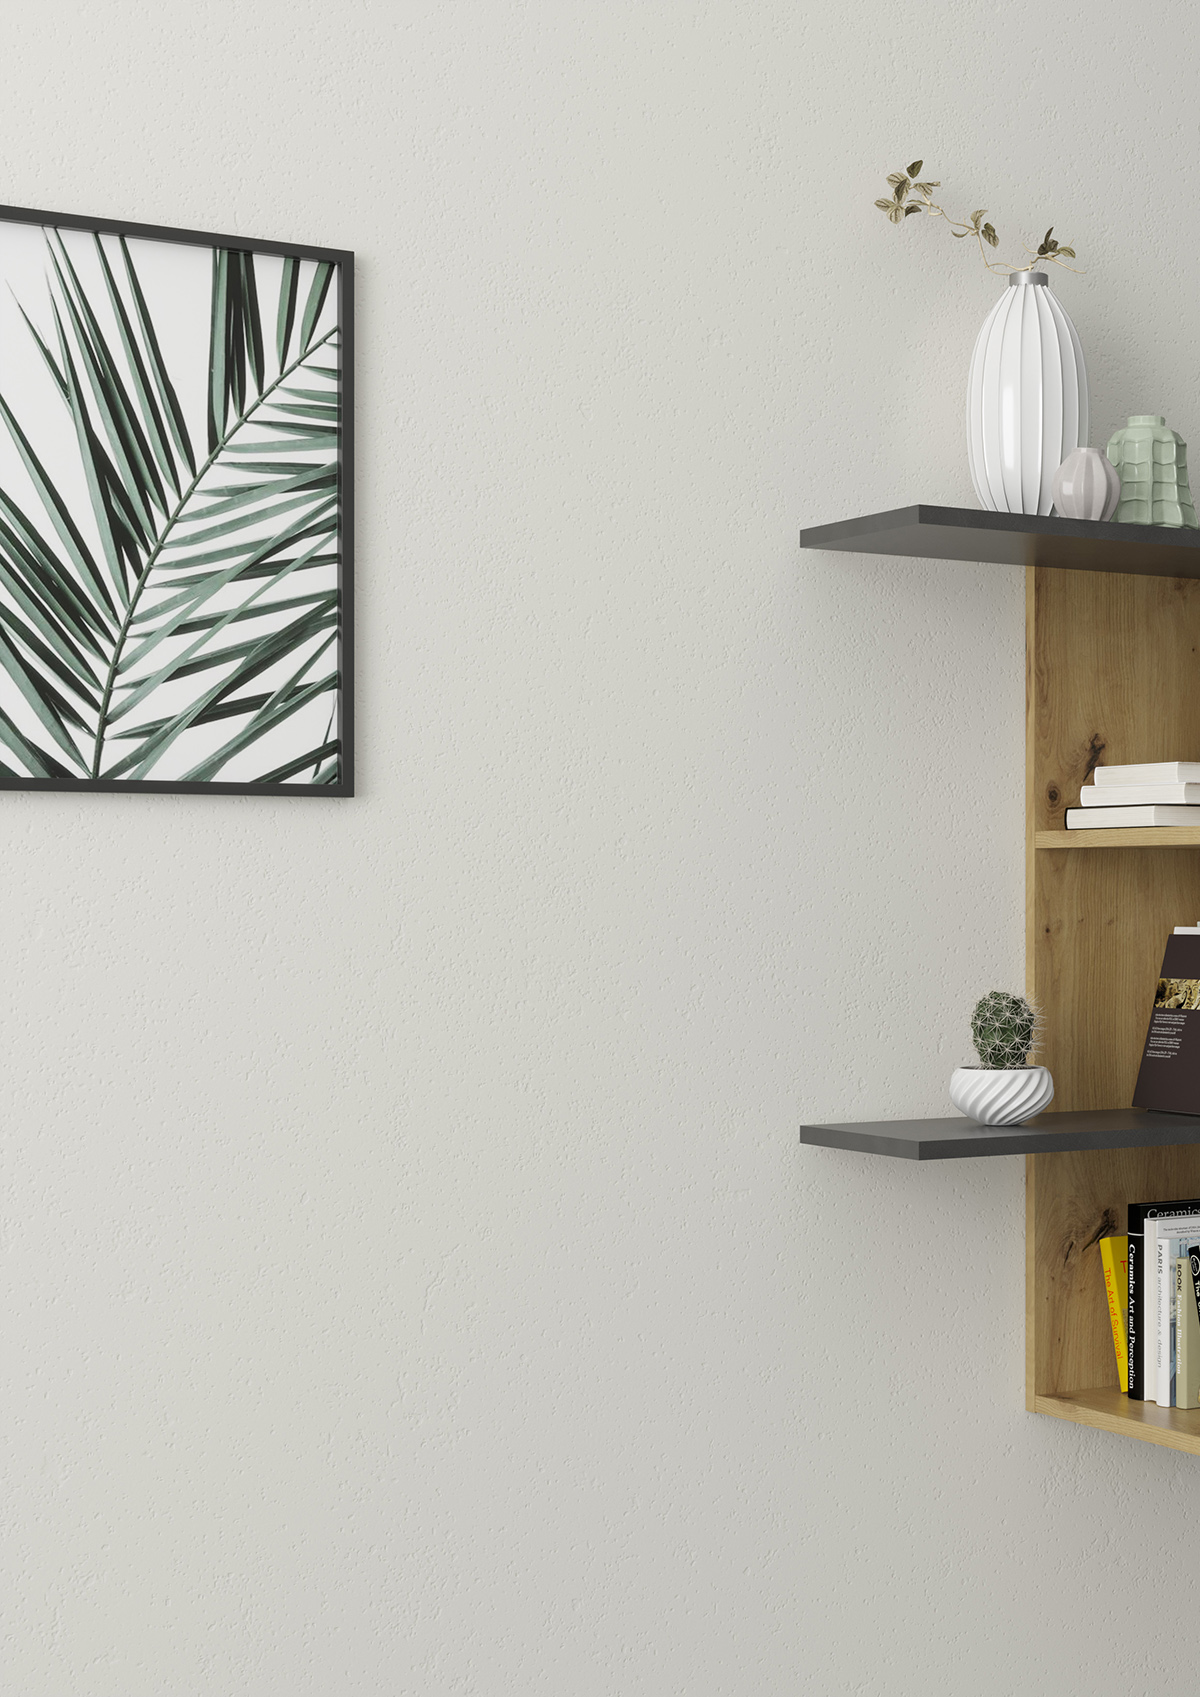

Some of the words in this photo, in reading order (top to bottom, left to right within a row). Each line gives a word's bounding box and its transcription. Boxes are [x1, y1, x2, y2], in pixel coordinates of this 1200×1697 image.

[1128, 1243, 1136, 1295] Ceramics
[1107, 1289, 1115, 1305] Art
[1128, 1296, 1136, 1314] Art
[1110, 1306, 1118, 1317] of
[1128, 1315, 1136, 1334] and
[1111, 1319, 1124, 1360] Survival
[1128, 1335, 1136, 1389] Perception
